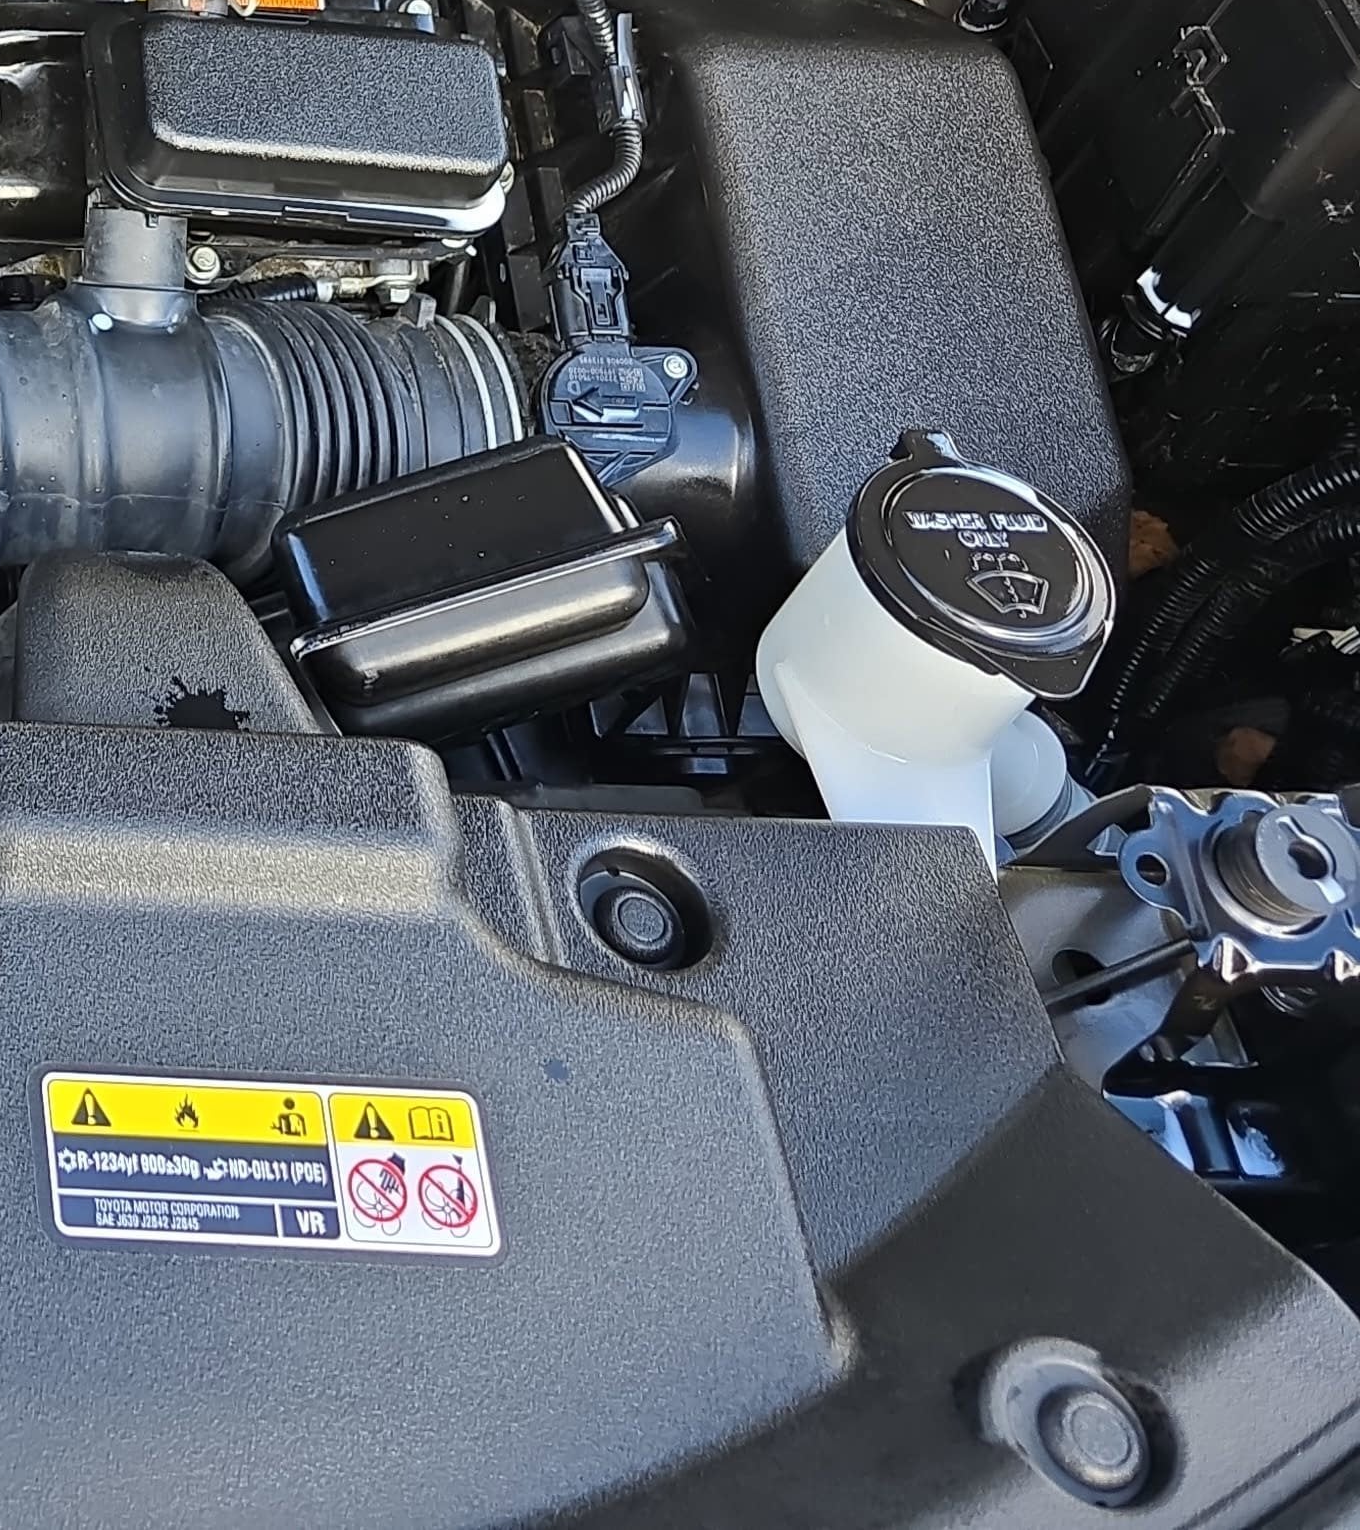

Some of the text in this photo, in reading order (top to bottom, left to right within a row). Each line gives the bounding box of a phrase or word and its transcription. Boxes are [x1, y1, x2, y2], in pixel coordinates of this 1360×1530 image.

[903, 510, 1048, 532] WASHER FLUID
[76, 1149, 139, 1177] R-1234yf
[228, 1157, 290, 1182] ND-OIL11
[291, 1160, 328, 1187] (POE)
[94, 1198, 240, 1219] TOYOTA MOTOR CORPORATION
[95, 1212, 115, 1226] SAE
[295, 1210, 327, 1235] VR
